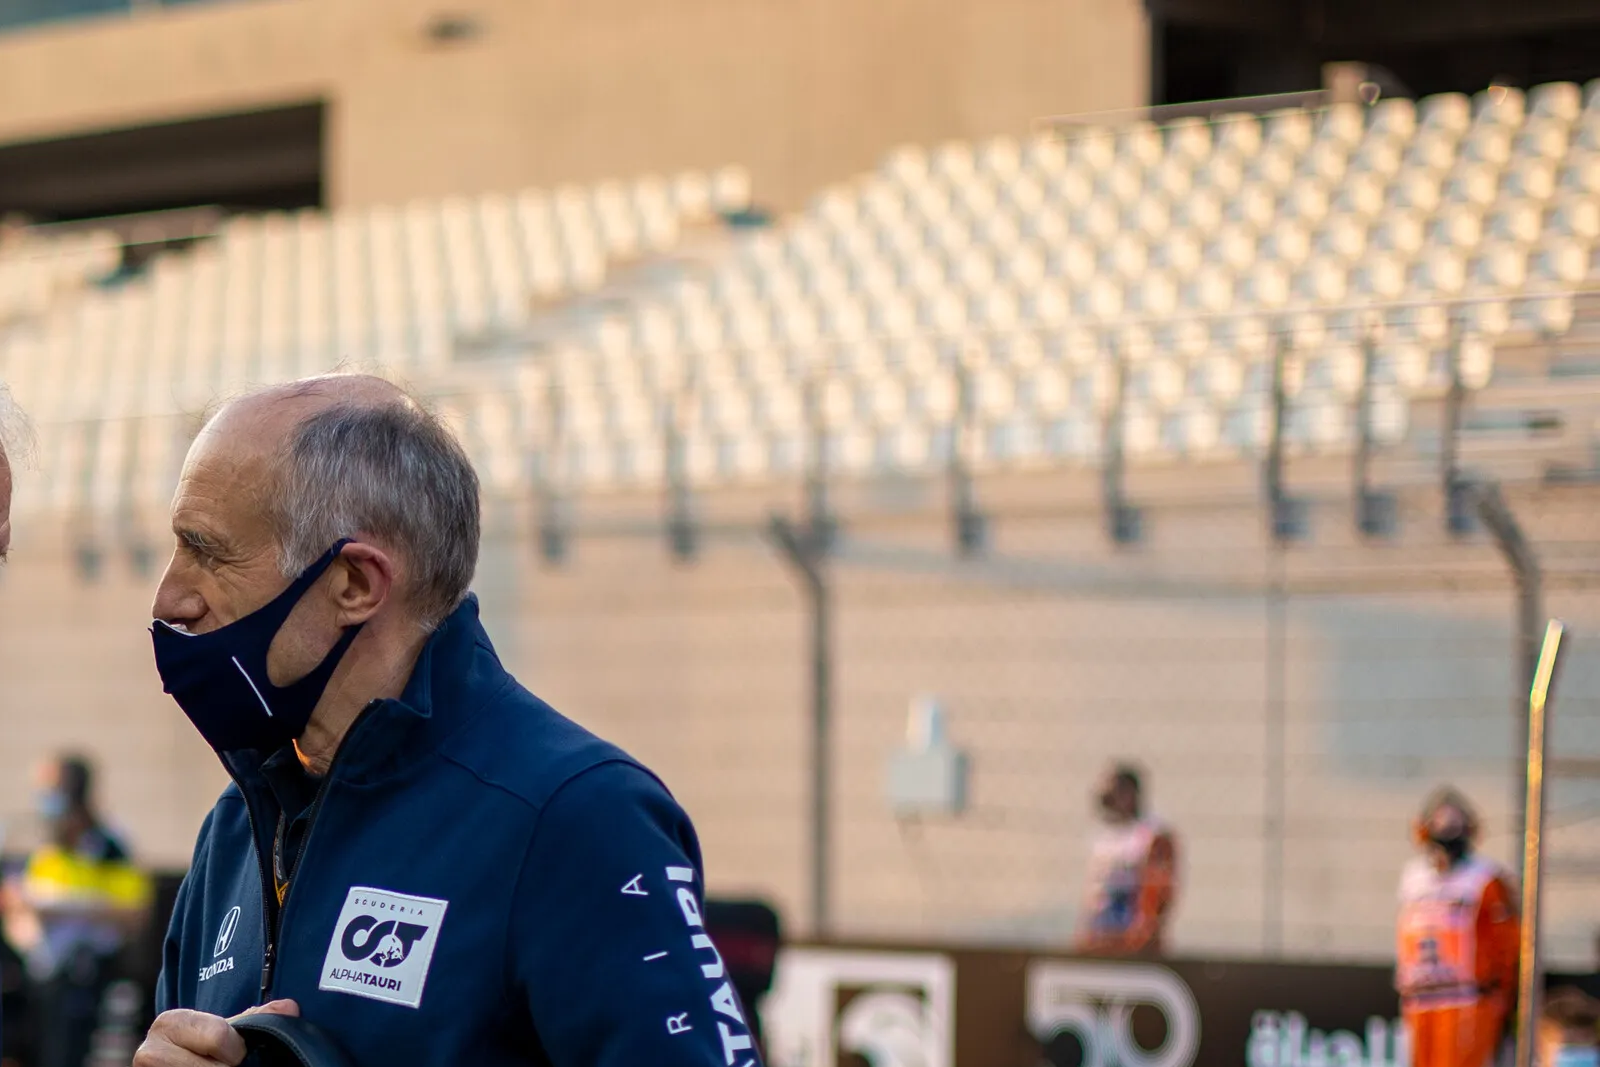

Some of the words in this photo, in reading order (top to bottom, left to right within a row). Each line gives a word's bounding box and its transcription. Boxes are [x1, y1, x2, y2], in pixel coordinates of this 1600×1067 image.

[354, 898, 424, 916] SCUDERIA
[198, 956, 234, 982] HONDA
[329, 967, 402, 992] ALPHATAURI
